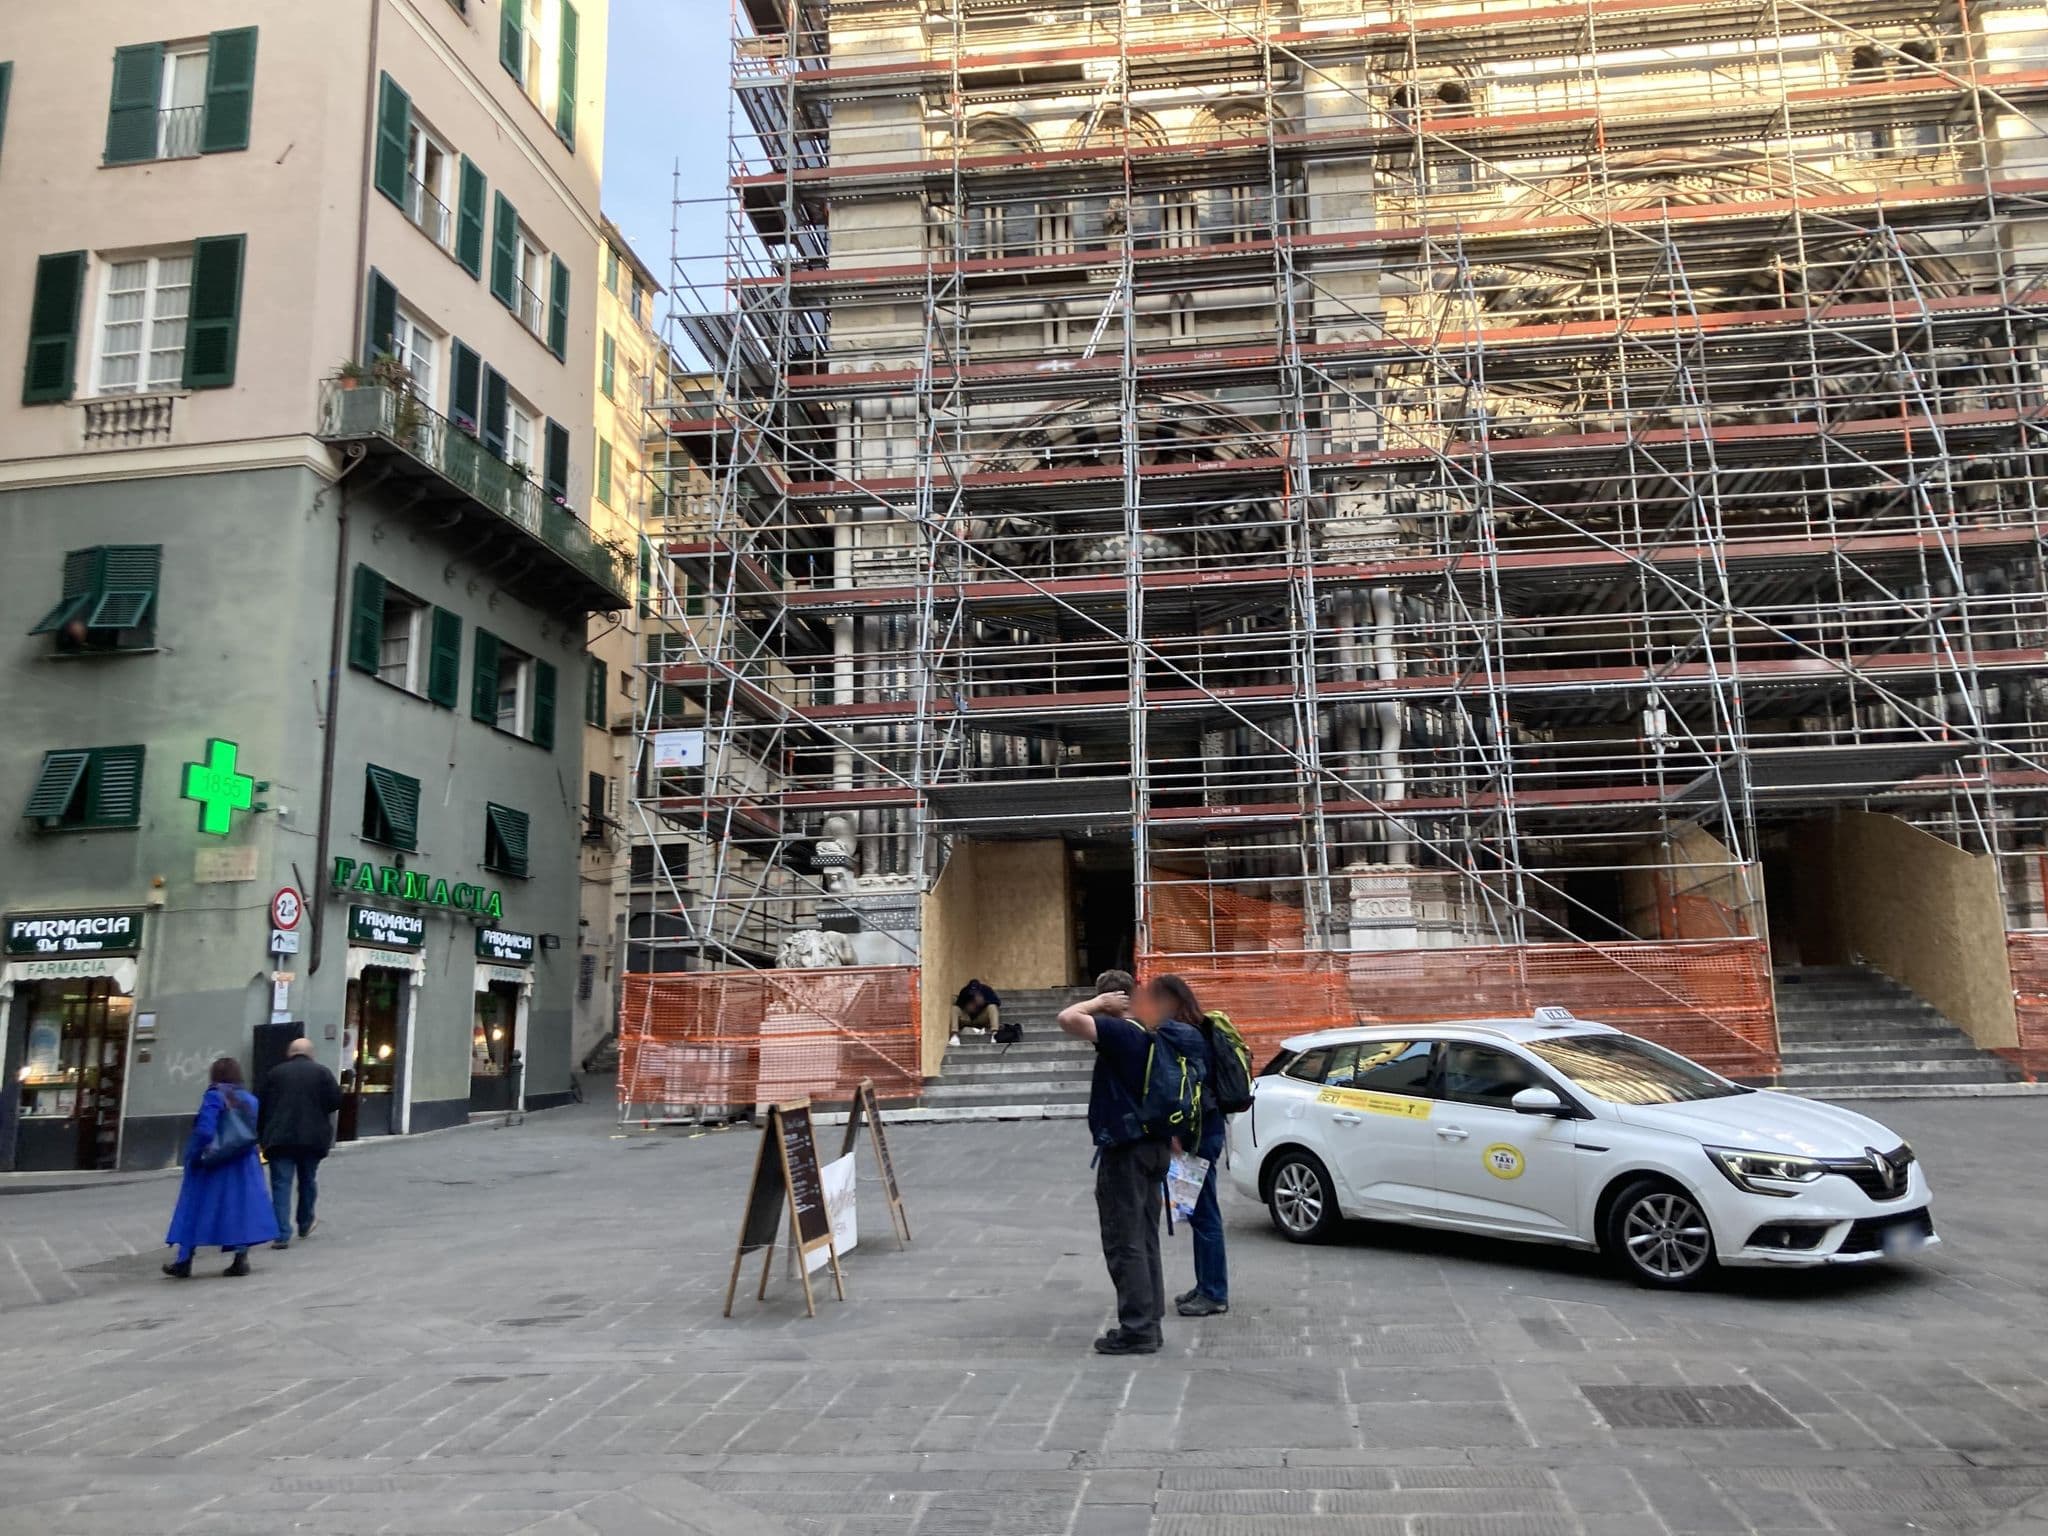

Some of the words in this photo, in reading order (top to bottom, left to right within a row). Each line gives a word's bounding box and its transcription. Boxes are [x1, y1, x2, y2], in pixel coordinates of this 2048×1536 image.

[331, 856, 503, 918] FARMACIA
[12, 917, 131, 938] FARMACIA
[358, 909, 423, 933] FARMACIA
[482, 929, 532, 950] FARMACIA
[27, 961, 107, 975] FARMACIA
[1542, 1008, 1574, 1020] TAXI
[1494, 1155, 1514, 1165] TAXI
